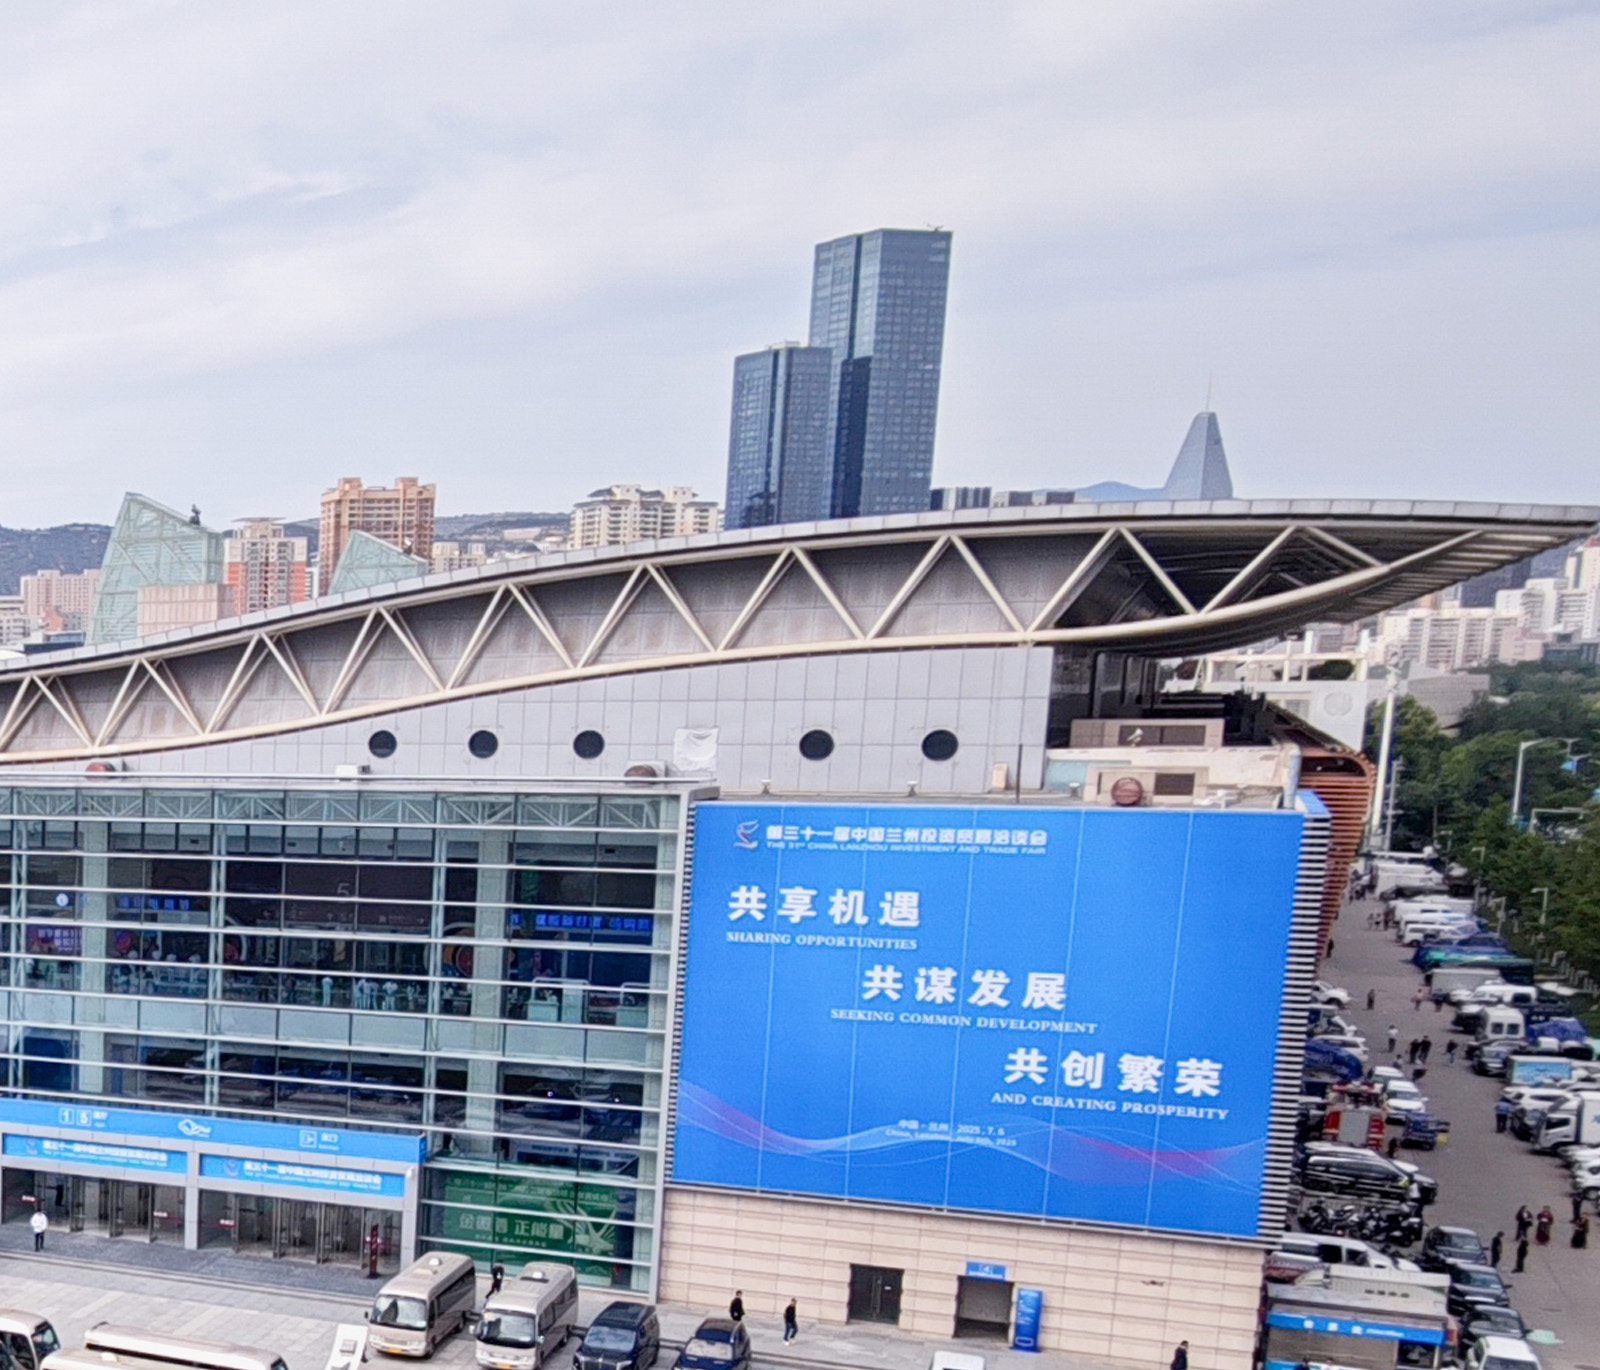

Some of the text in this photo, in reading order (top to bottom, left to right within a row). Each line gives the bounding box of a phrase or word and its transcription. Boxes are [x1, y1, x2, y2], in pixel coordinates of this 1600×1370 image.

[728, 885, 920, 927] 共享机遇
[726, 931, 917, 950] SHARING OPPORTUNITIES
[861, 964, 1067, 1011] 共谋发展
[831, 1009, 1098, 1034] SEEKING COMMON DEVELOPMENT
[1004, 1047, 1223, 1097] 共创繁荣
[991, 1092, 1229, 1120] AND CREATING PROSPERITY
